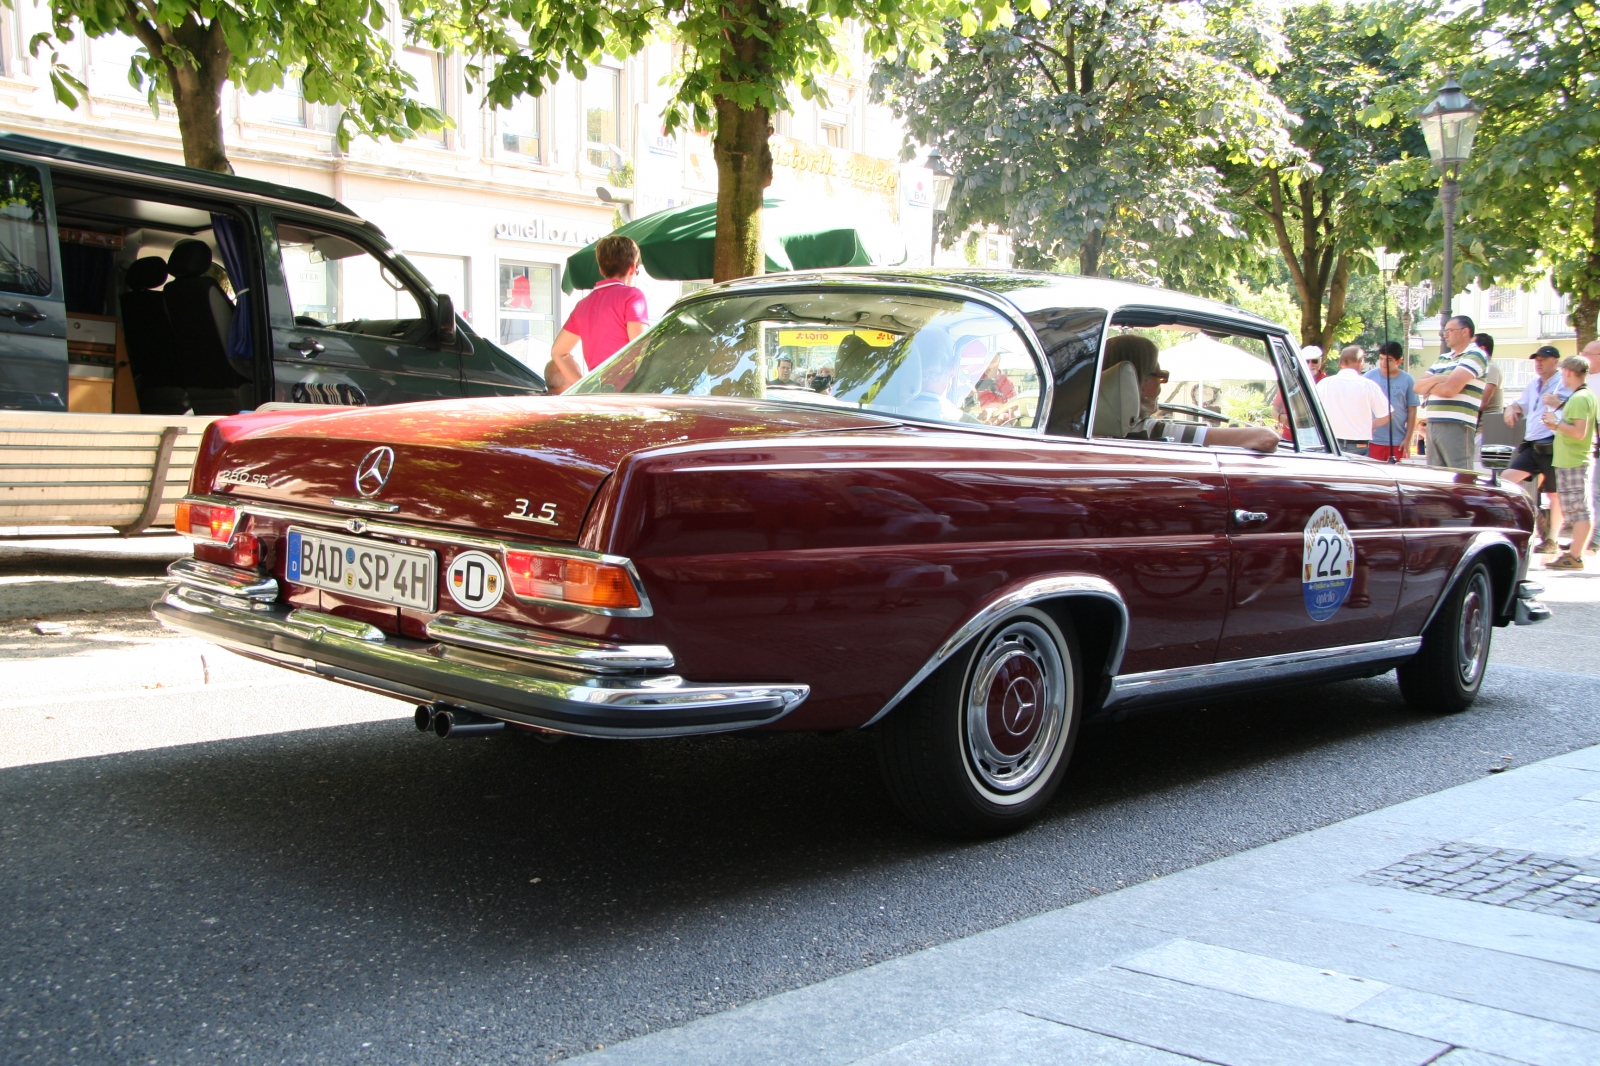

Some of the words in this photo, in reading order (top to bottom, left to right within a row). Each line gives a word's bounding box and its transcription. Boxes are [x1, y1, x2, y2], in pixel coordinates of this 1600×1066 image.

[805, 332, 829, 341] LOTTO
[223, 470, 250, 482] 280
[510, 498, 558, 521] 3.5
[291, 560, 298, 572] D
[300, 539, 343, 584] BAD
[1317, 535, 1342, 577] 22
[464, 561, 485, 602] D
